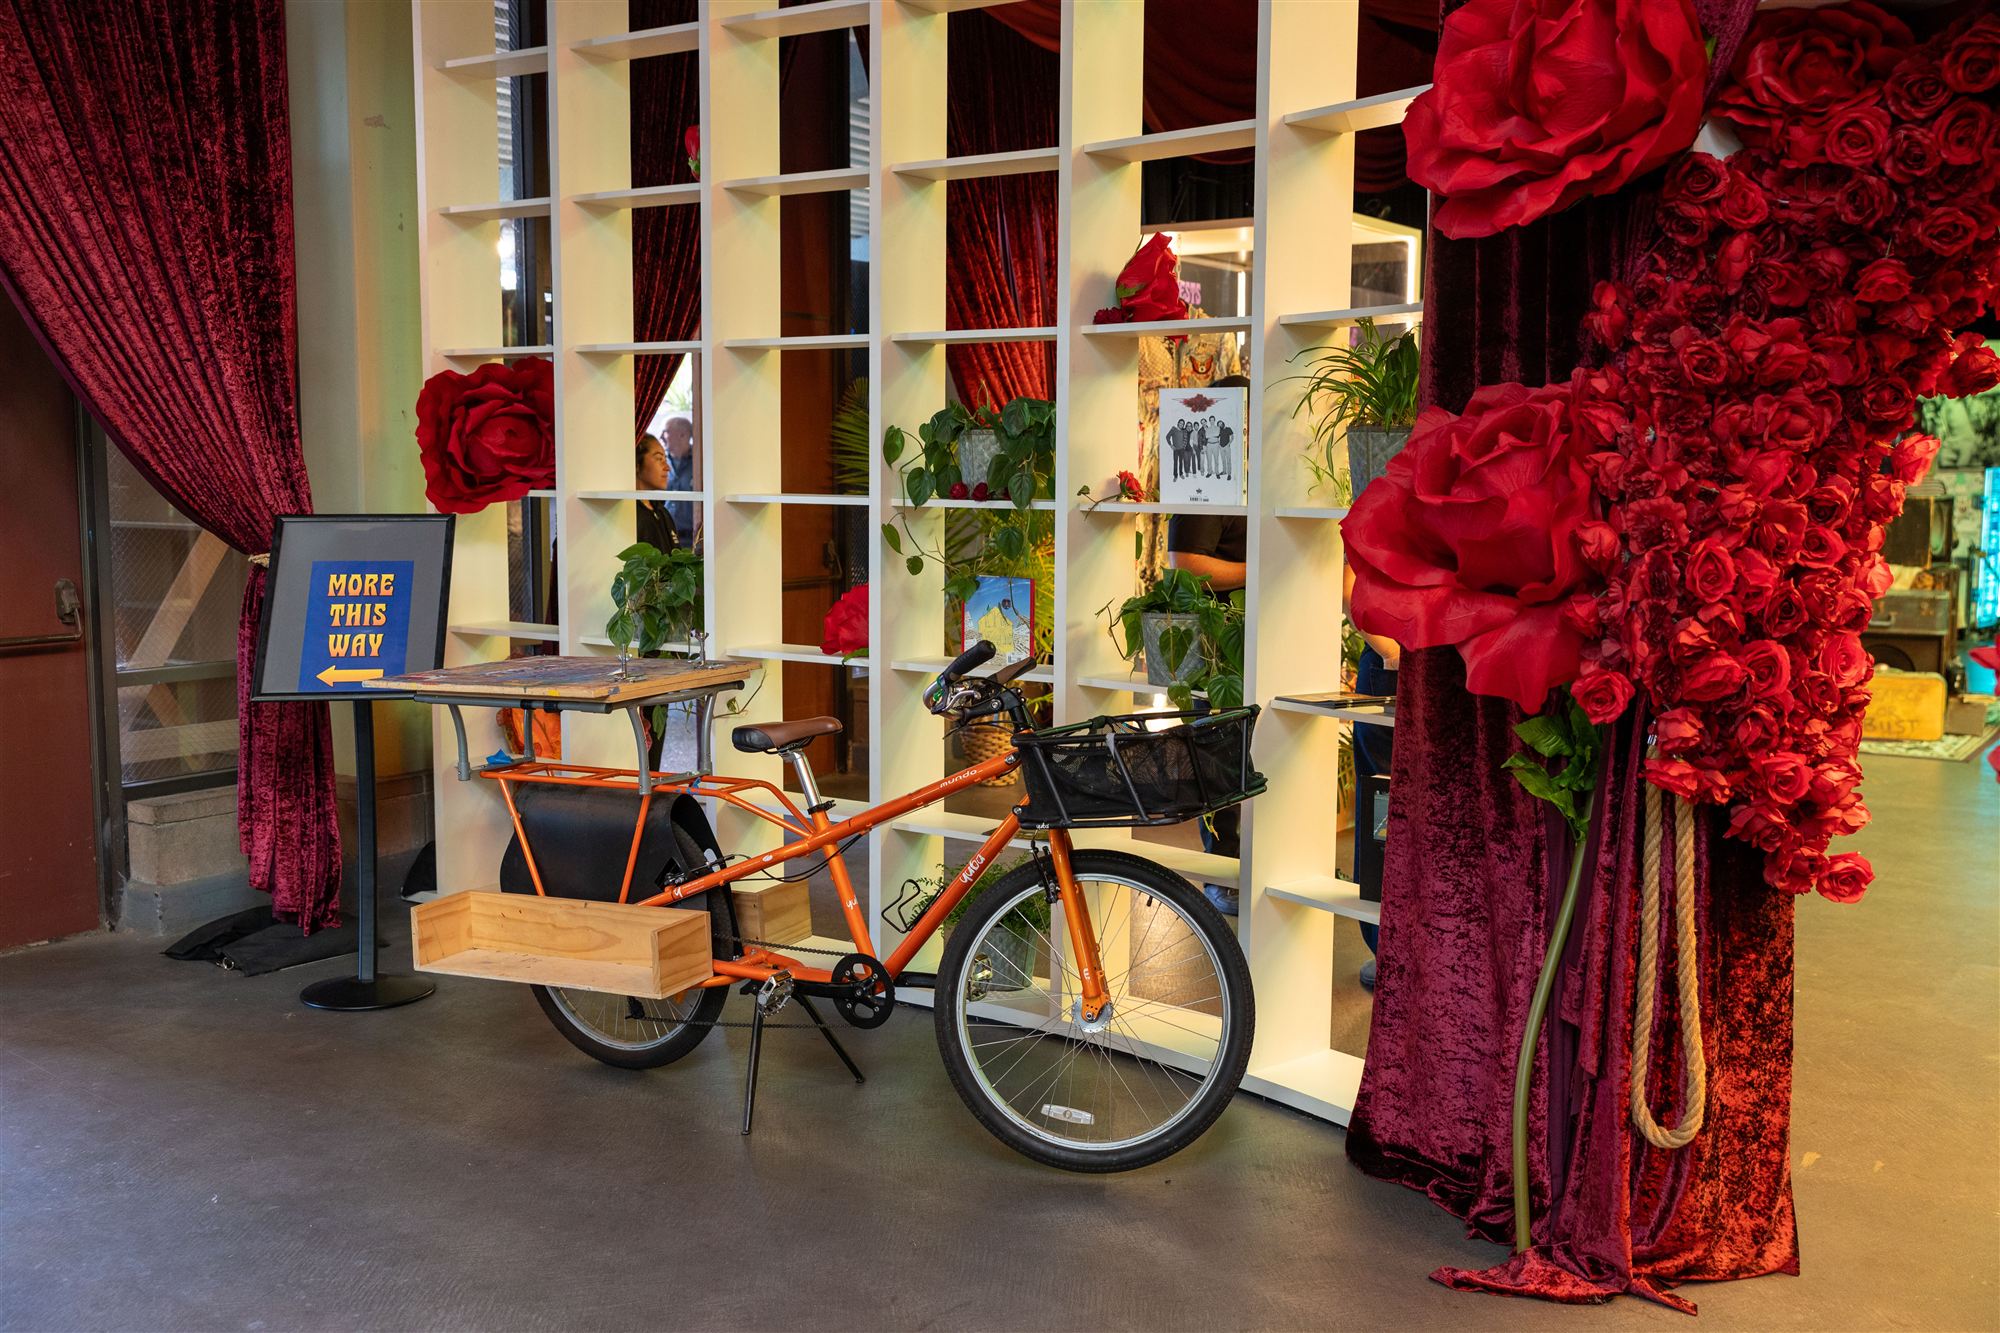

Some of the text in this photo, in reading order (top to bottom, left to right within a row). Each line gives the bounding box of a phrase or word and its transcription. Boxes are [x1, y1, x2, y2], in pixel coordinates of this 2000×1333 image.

[327, 573, 395, 597] MORE
[329, 603, 387, 627] THIS
[328, 633, 384, 657] WAY
[939, 769, 978, 789] mundo
[959, 853, 986, 884] yuba
